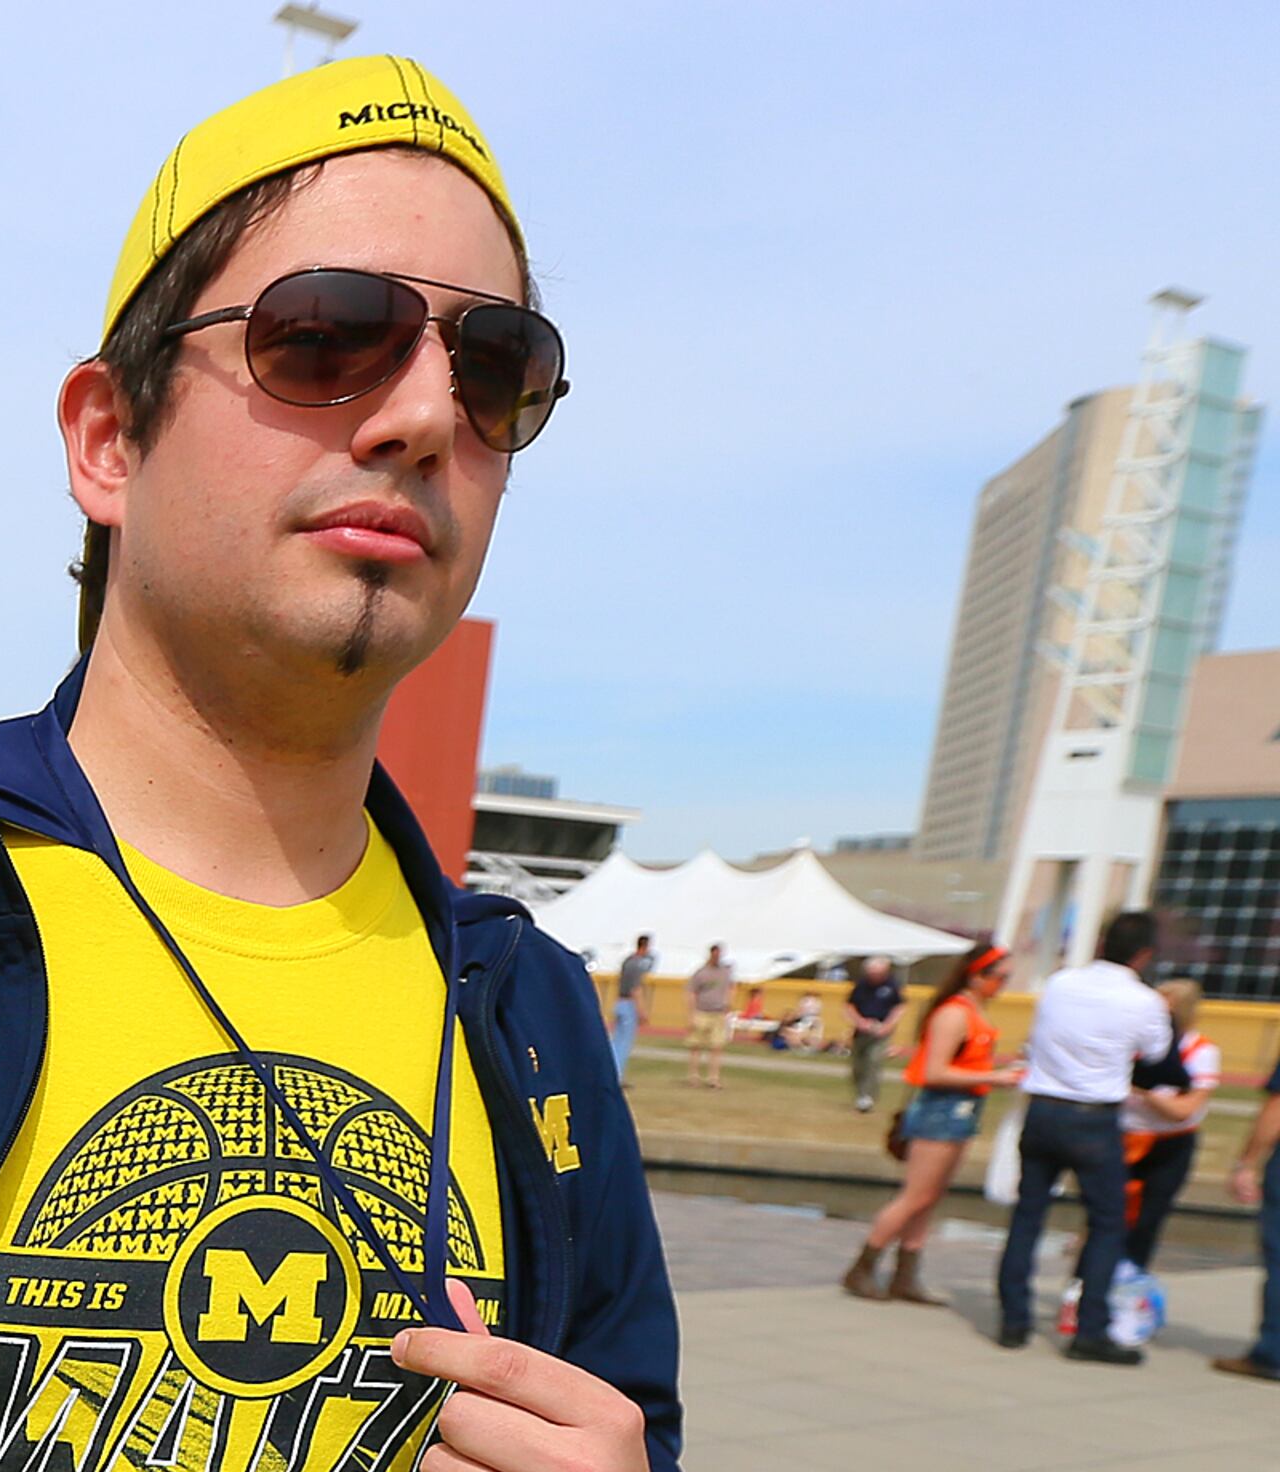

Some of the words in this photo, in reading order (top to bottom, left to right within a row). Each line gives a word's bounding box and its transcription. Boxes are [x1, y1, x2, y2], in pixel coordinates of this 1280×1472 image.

[6, 1275, 83, 1309] THIS
[86, 1279, 128, 1311] IS
[196, 1248, 329, 1344] M
[370, 1291, 501, 1327] MIAN
